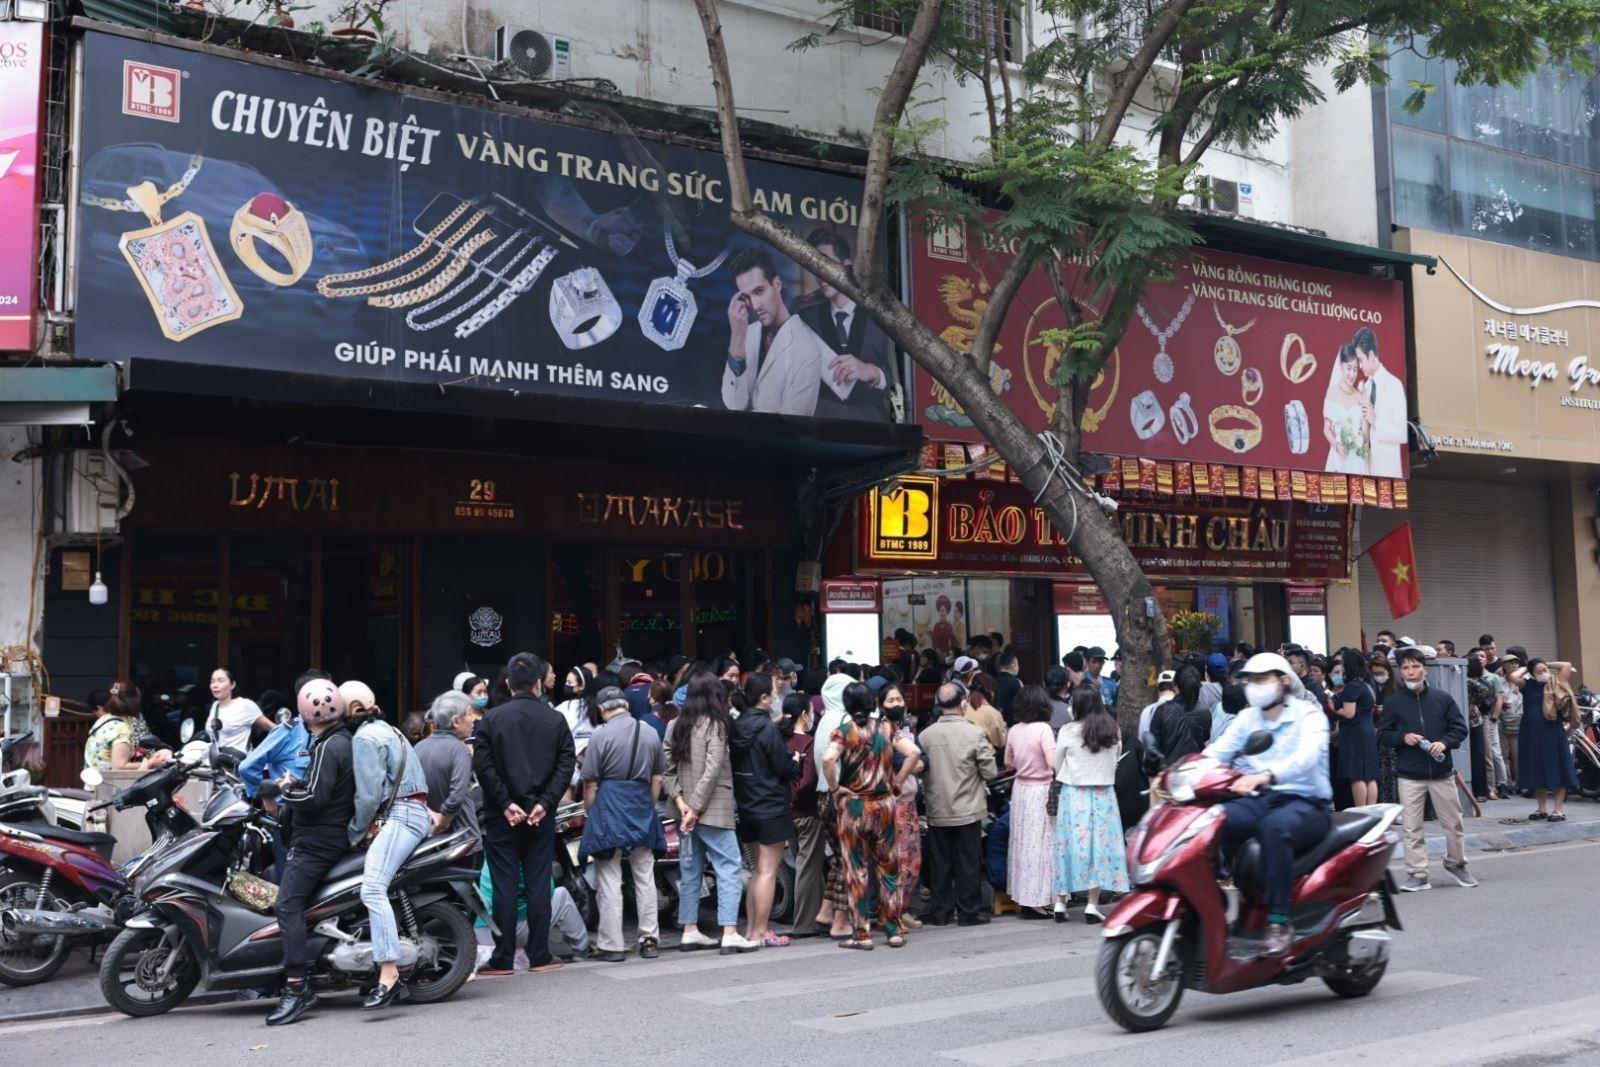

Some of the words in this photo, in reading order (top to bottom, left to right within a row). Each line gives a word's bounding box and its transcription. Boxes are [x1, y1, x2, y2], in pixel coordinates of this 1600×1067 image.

[211, 90, 353, 151] CHUYÊN
[361, 114, 441, 172] BIỆT
[456, 131, 549, 173] VÀNG
[557, 151, 660, 192] TRANG
[667, 170, 724, 203] SỨC
[752, 188, 793, 216] AM
[800, 197, 858, 226] GIỚI
[1192, 261, 1226, 280] VÀNG
[1227, 265, 1261, 286] RỒNG
[1302, 282, 1332, 298] LONG
[1192, 282, 1226, 301] VÀNG
[1227, 288, 1266, 307] TRANG
[1267, 292, 1290, 310] SỨC
[1291, 296, 1320, 315] CHẤT
[1321, 301, 1358, 322] LƯỢNG
[1359, 309, 1382, 324] CAO
[334, 340, 396, 366] GIÚP
[404, 348, 462, 374] PHÁI
[470, 356, 539, 382] MẠNH
[546, 362, 602, 387] THÊM
[610, 372, 670, 394] SANG
[1486, 342, 1559, 388] Mega
[229, 471, 339, 512] UMAI
[470, 479, 496, 501] 29
[950, 490, 1027, 544] BẢO
[1206, 507, 1289, 552] CHÂU
[880, 540, 904, 549] BTMC
[908, 541, 929, 550] 1989
